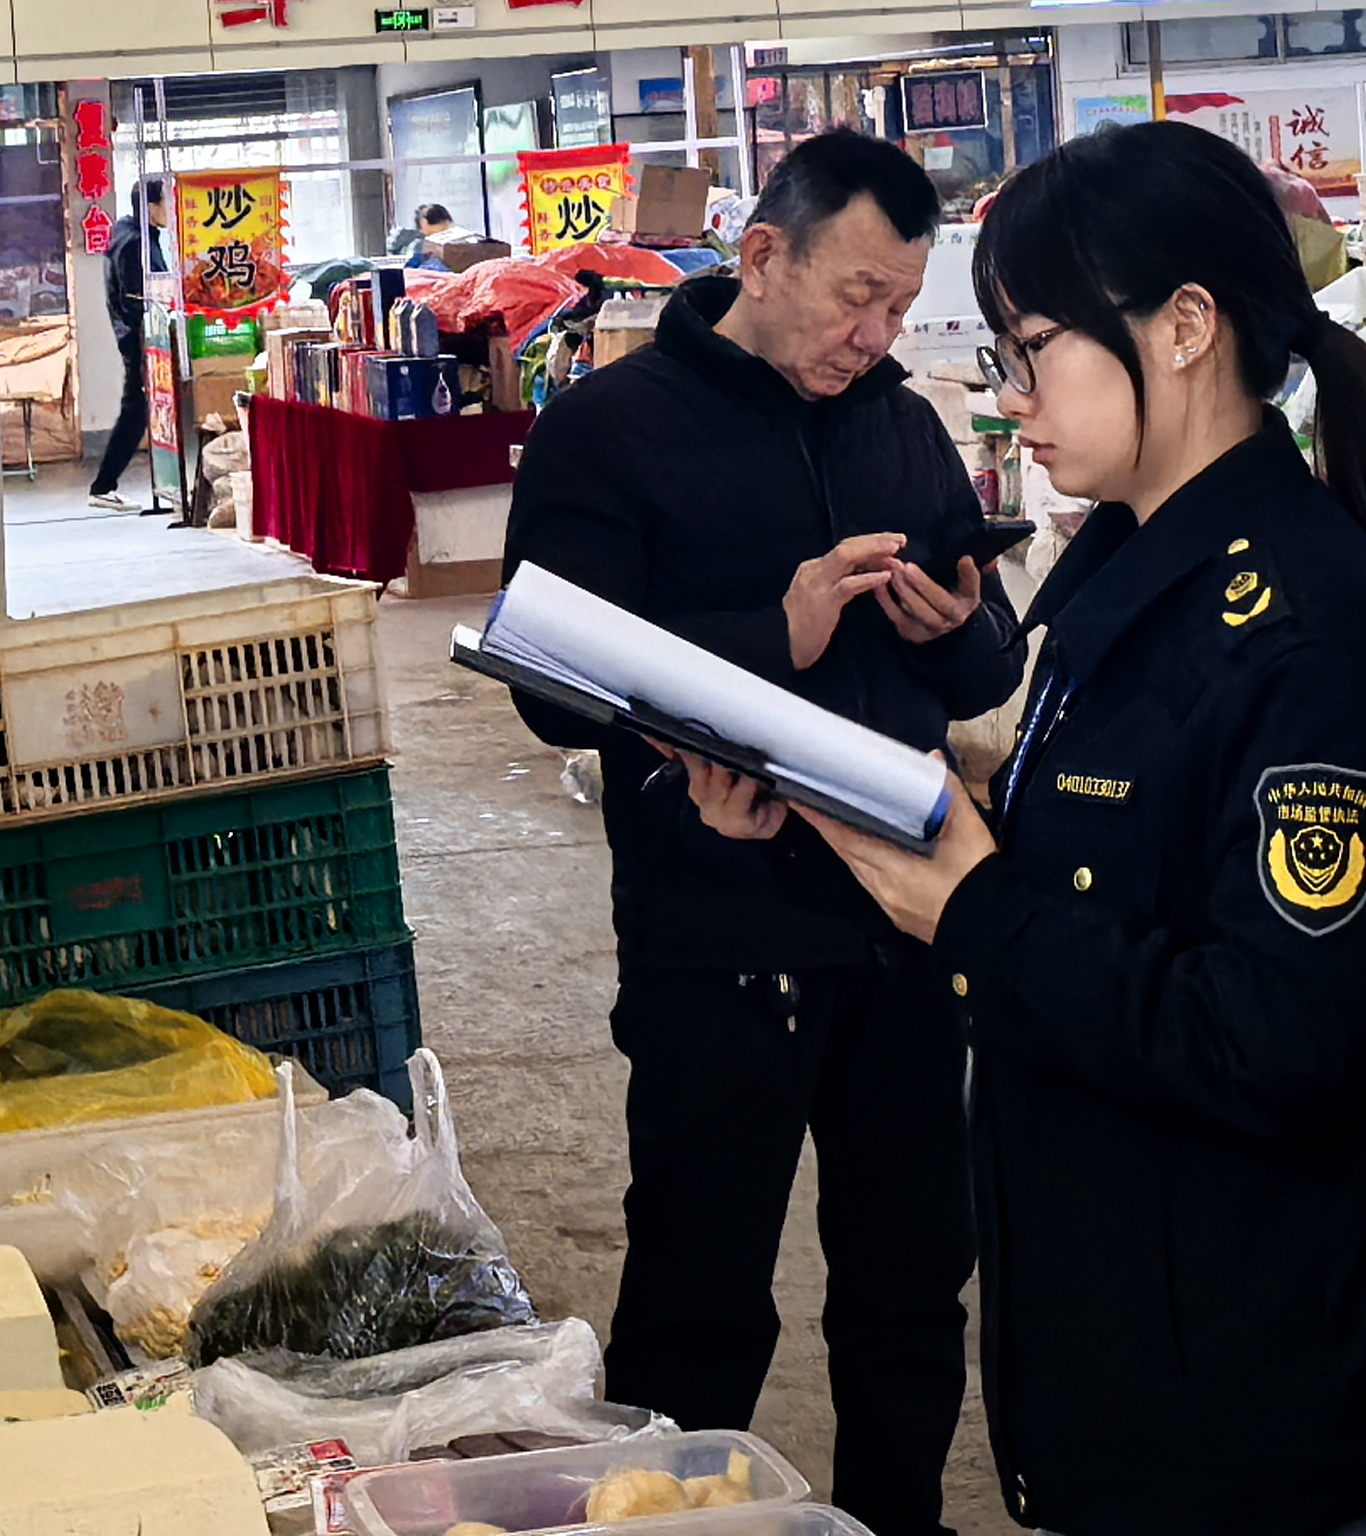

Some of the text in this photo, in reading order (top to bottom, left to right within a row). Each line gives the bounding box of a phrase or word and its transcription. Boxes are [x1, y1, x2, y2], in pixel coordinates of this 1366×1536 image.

[1286, 104, 1331, 170] 诚信
[202, 183, 256, 288] 炒鸡
[556, 194, 605, 239] 炒
